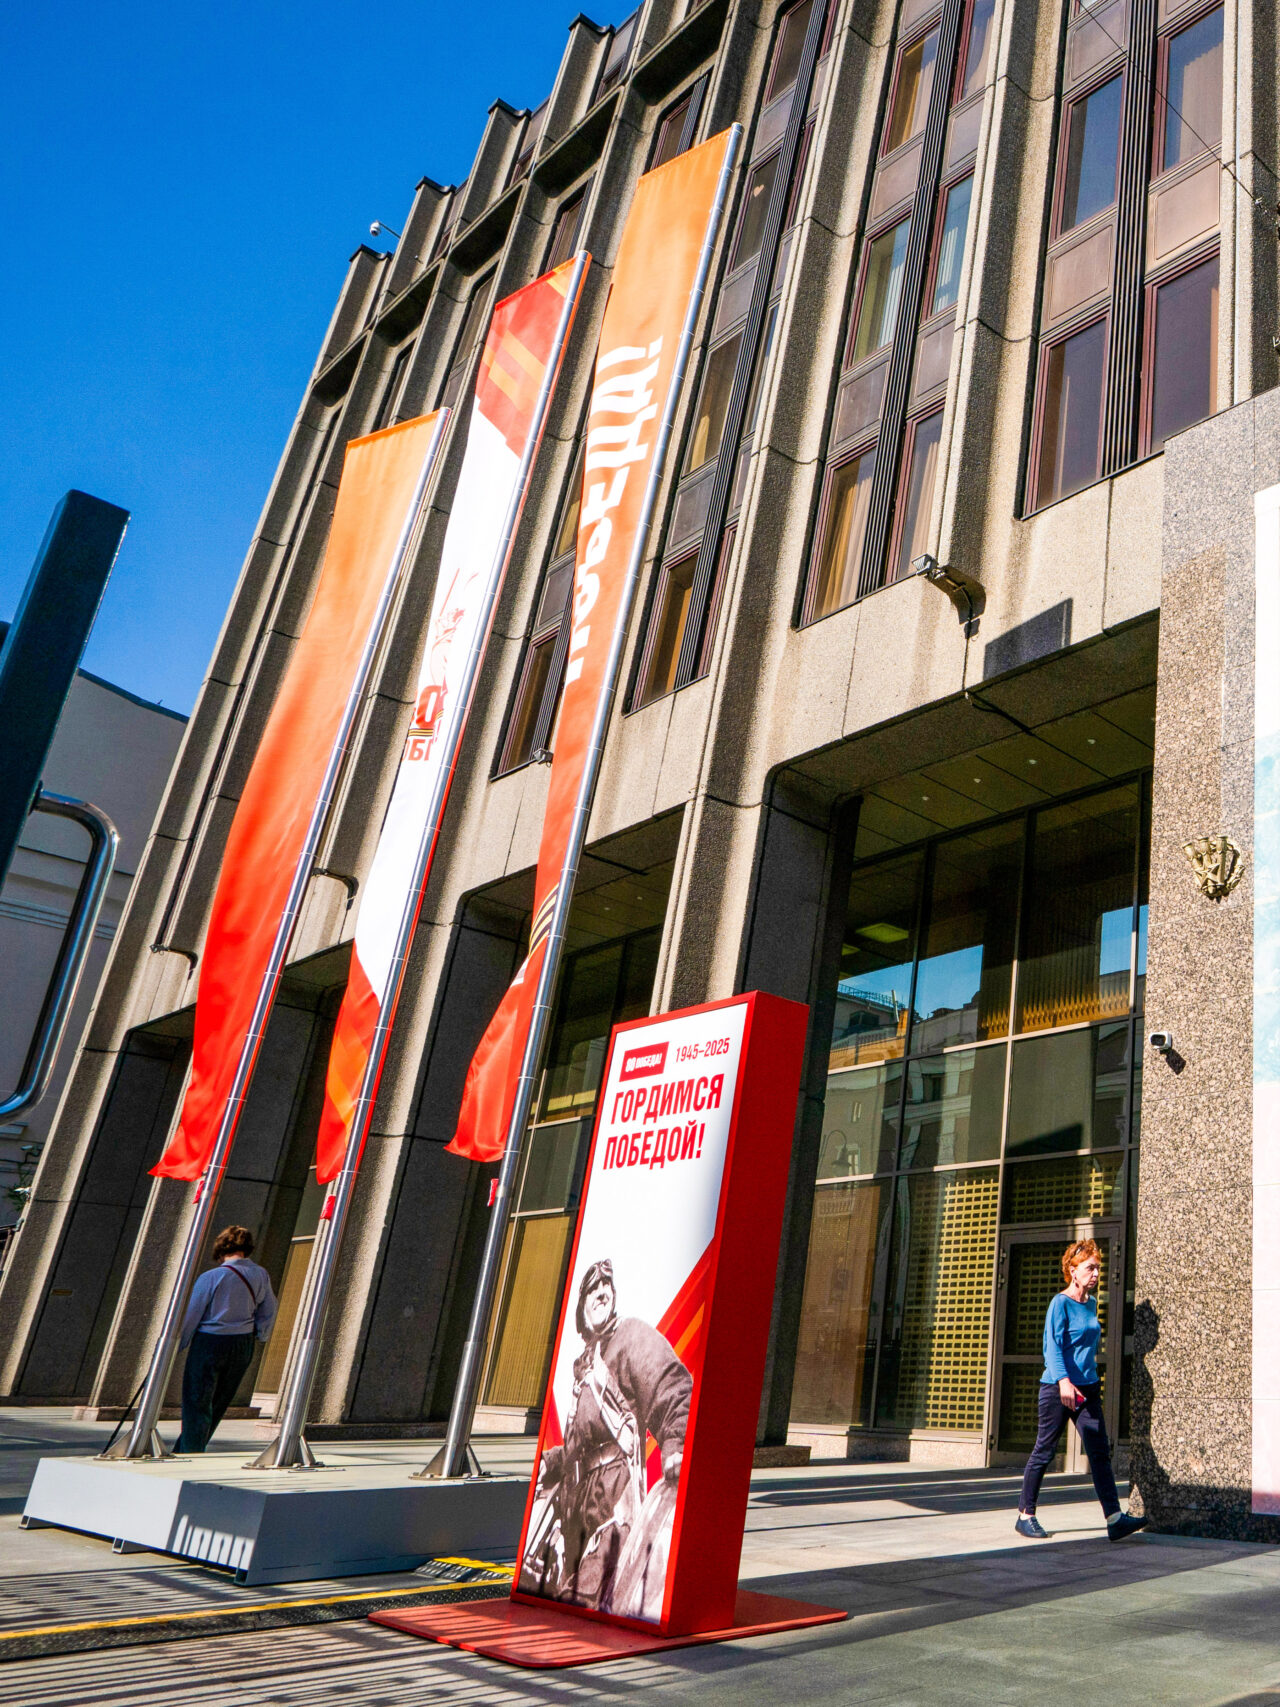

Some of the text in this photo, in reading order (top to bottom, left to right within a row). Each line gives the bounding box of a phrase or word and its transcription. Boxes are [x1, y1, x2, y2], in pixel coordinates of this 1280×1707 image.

[676, 1037, 730, 1062] 1945-2025
[611, 1073, 725, 1125] ГОРДИМСЯ
[603, 1119, 705, 1170] ПОБЕДОЙ!
